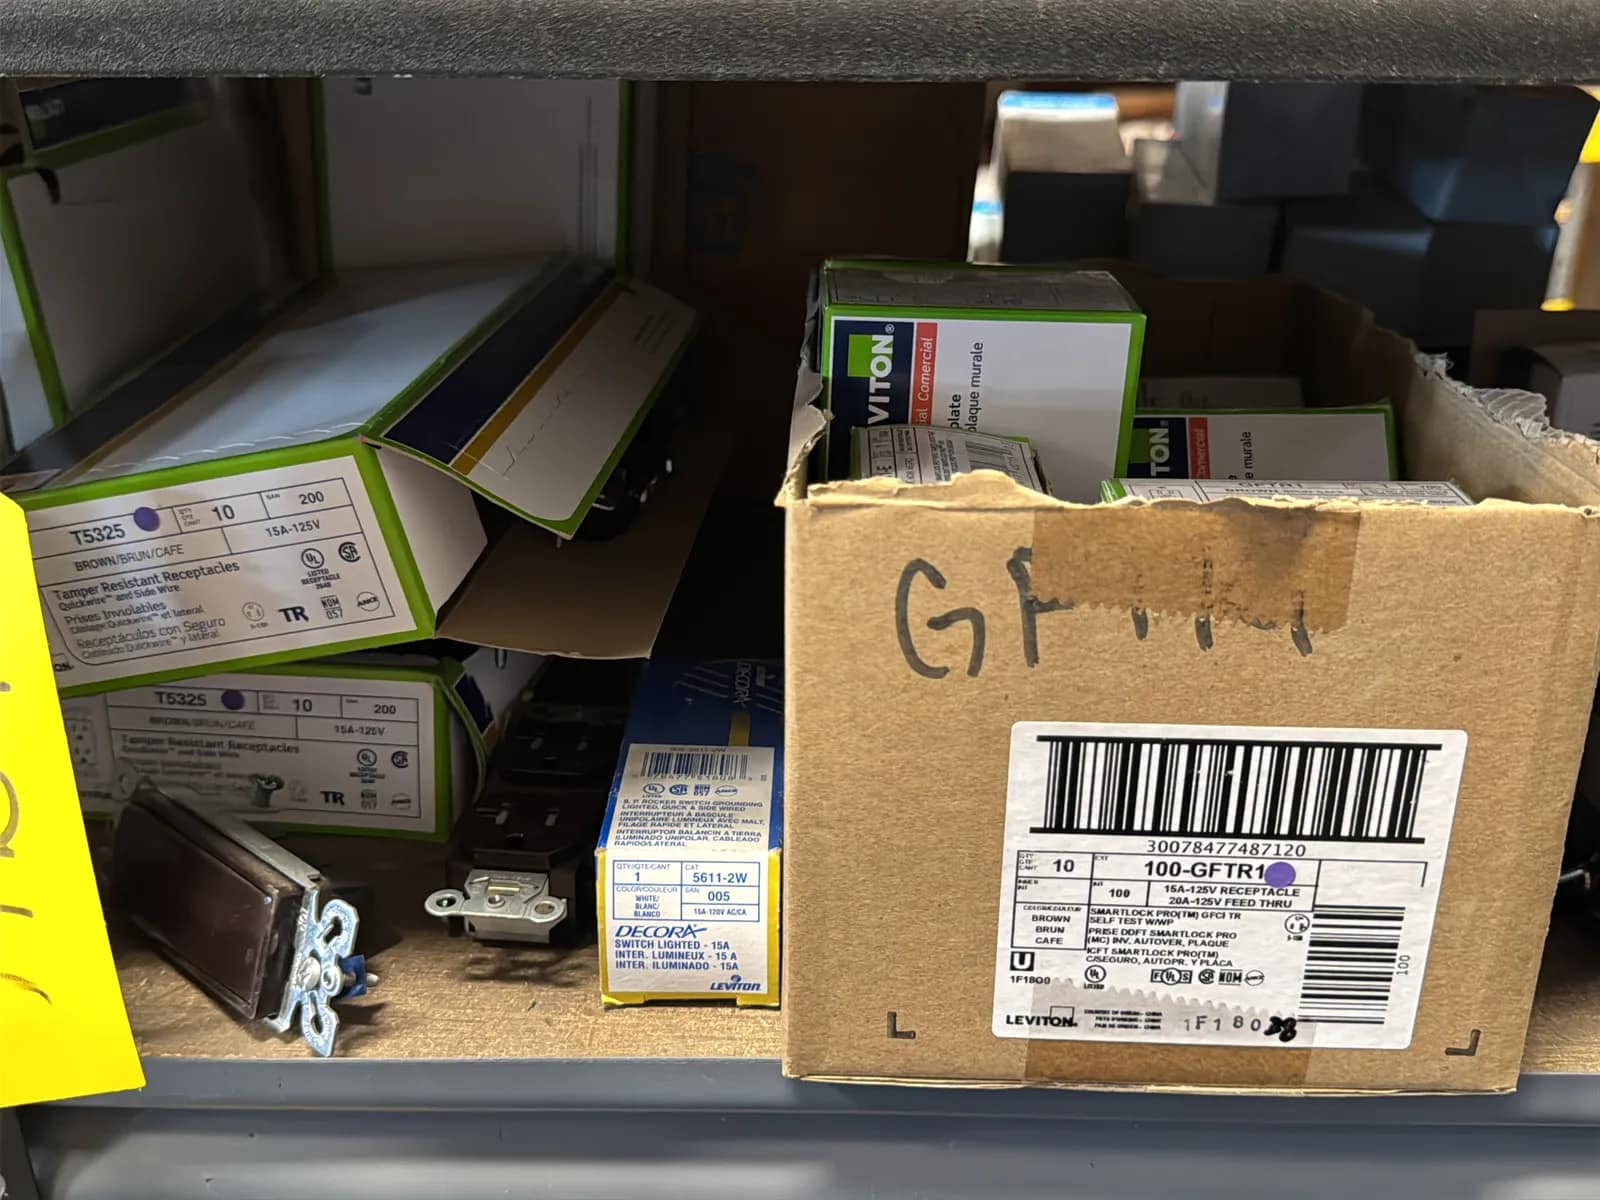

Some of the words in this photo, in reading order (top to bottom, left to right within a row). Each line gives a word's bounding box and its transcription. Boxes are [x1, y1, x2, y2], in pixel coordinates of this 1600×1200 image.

[917, 338, 934, 401] Comercial
[970, 342, 984, 388] murale
[1240, 432, 1252, 468] murale
[299, 492, 324, 504] 200
[212, 505, 235, 521] 10
[70, 524, 126, 545] T5325
[266, 520, 320, 537] 15A-125V
[75, 544, 184, 572] BROWN/BRUN/CAFE
[53, 585, 99, 601] Tamper
[101, 574, 163, 593] Resistant
[163, 561, 240, 582] Receptacles
[135, 588, 156, 599] Side
[160, 584, 180, 594] Wire
[64, 612, 100, 625] Prises
[104, 601, 167, 619] Inviolables
[278, 606, 309, 622] TR
[160, 624, 181, 637] con
[184, 618, 226, 633] Seguro
[154, 691, 207, 706] T5325
[293, 699, 312, 712] 10
[374, 704, 396, 714] 200
[334, 725, 385, 736] 15A-125V
[320, 791, 345, 806] TR
[1147, 840, 1307, 858] 30078477487120
[1053, 858, 1074, 872] 10
[1144, 860, 1266, 880] 100-GFTR1
[634, 872, 640, 882] 1
[693, 872, 748, 884] 5611-2W
[708, 891, 730, 902] 005
[1108, 888, 1130, 898] 100
[1164, 885, 1218, 894] 15A-125V
[1220, 886, 1300, 897] RECEPTACLE
[635, 895, 660, 903] WHITE/
[1169, 896, 1222, 906] 20A-125V
[1225, 898, 1256, 907] FEED
[1259, 899, 1292, 908] THRU
[635, 903, 660, 911] BLANC/
[694, 908, 724, 916] 15A-120V
[726, 908, 747, 916] AC/CA
[1032, 914, 1071, 922] BROWN
[1090, 908, 1154, 918] SMARTLOCK
[1156, 910, 1199, 920] PRO(TM)
[1228, 912, 1241, 920] TR
[1146, 918, 1174, 926] W/WP
[615, 924, 707, 938] DECORA
[1035, 926, 1065, 934] BRUN
[1088, 928, 1118, 936] PRISE
[1121, 928, 1147, 936] DDFT
[1150, 930, 1214, 938] SMARTLOCK
[1216, 932, 1237, 940] PRO
[615, 939, 652, 949] SWITCH
[658, 940, 700, 950] LIGHTED
[712, 942, 730, 950] 15A
[1035, 937, 1064, 945] CAFE
[1087, 936, 1110, 945] (MC)
[1112, 937, 1132, 945] INV.
[1134, 938, 1186, 947] AUTOVER,
[1188, 939, 1230, 948] PLAQUE
[616, 950, 648, 959] INTER.
[652, 951, 704, 960] LUMINEUX
[716, 952, 728, 960] 15
[1111, 948, 1174, 957] SMARTLOCK
[1177, 950, 1219, 959] PRO(TM)
[616, 960, 648, 969] INTER.
[653, 961, 710, 970] ILUMINADO
[721, 962, 738, 970] 15A
[1086, 955, 1142, 965] C/SEGURO,
[1143, 956, 1188, 966] AUTOPR.
[1191, 958, 1198, 966] Y
[1397, 954, 1410, 976] 100
[1219, 972, 1242, 983] NOM
[710, 981, 761, 992] LEVITON
